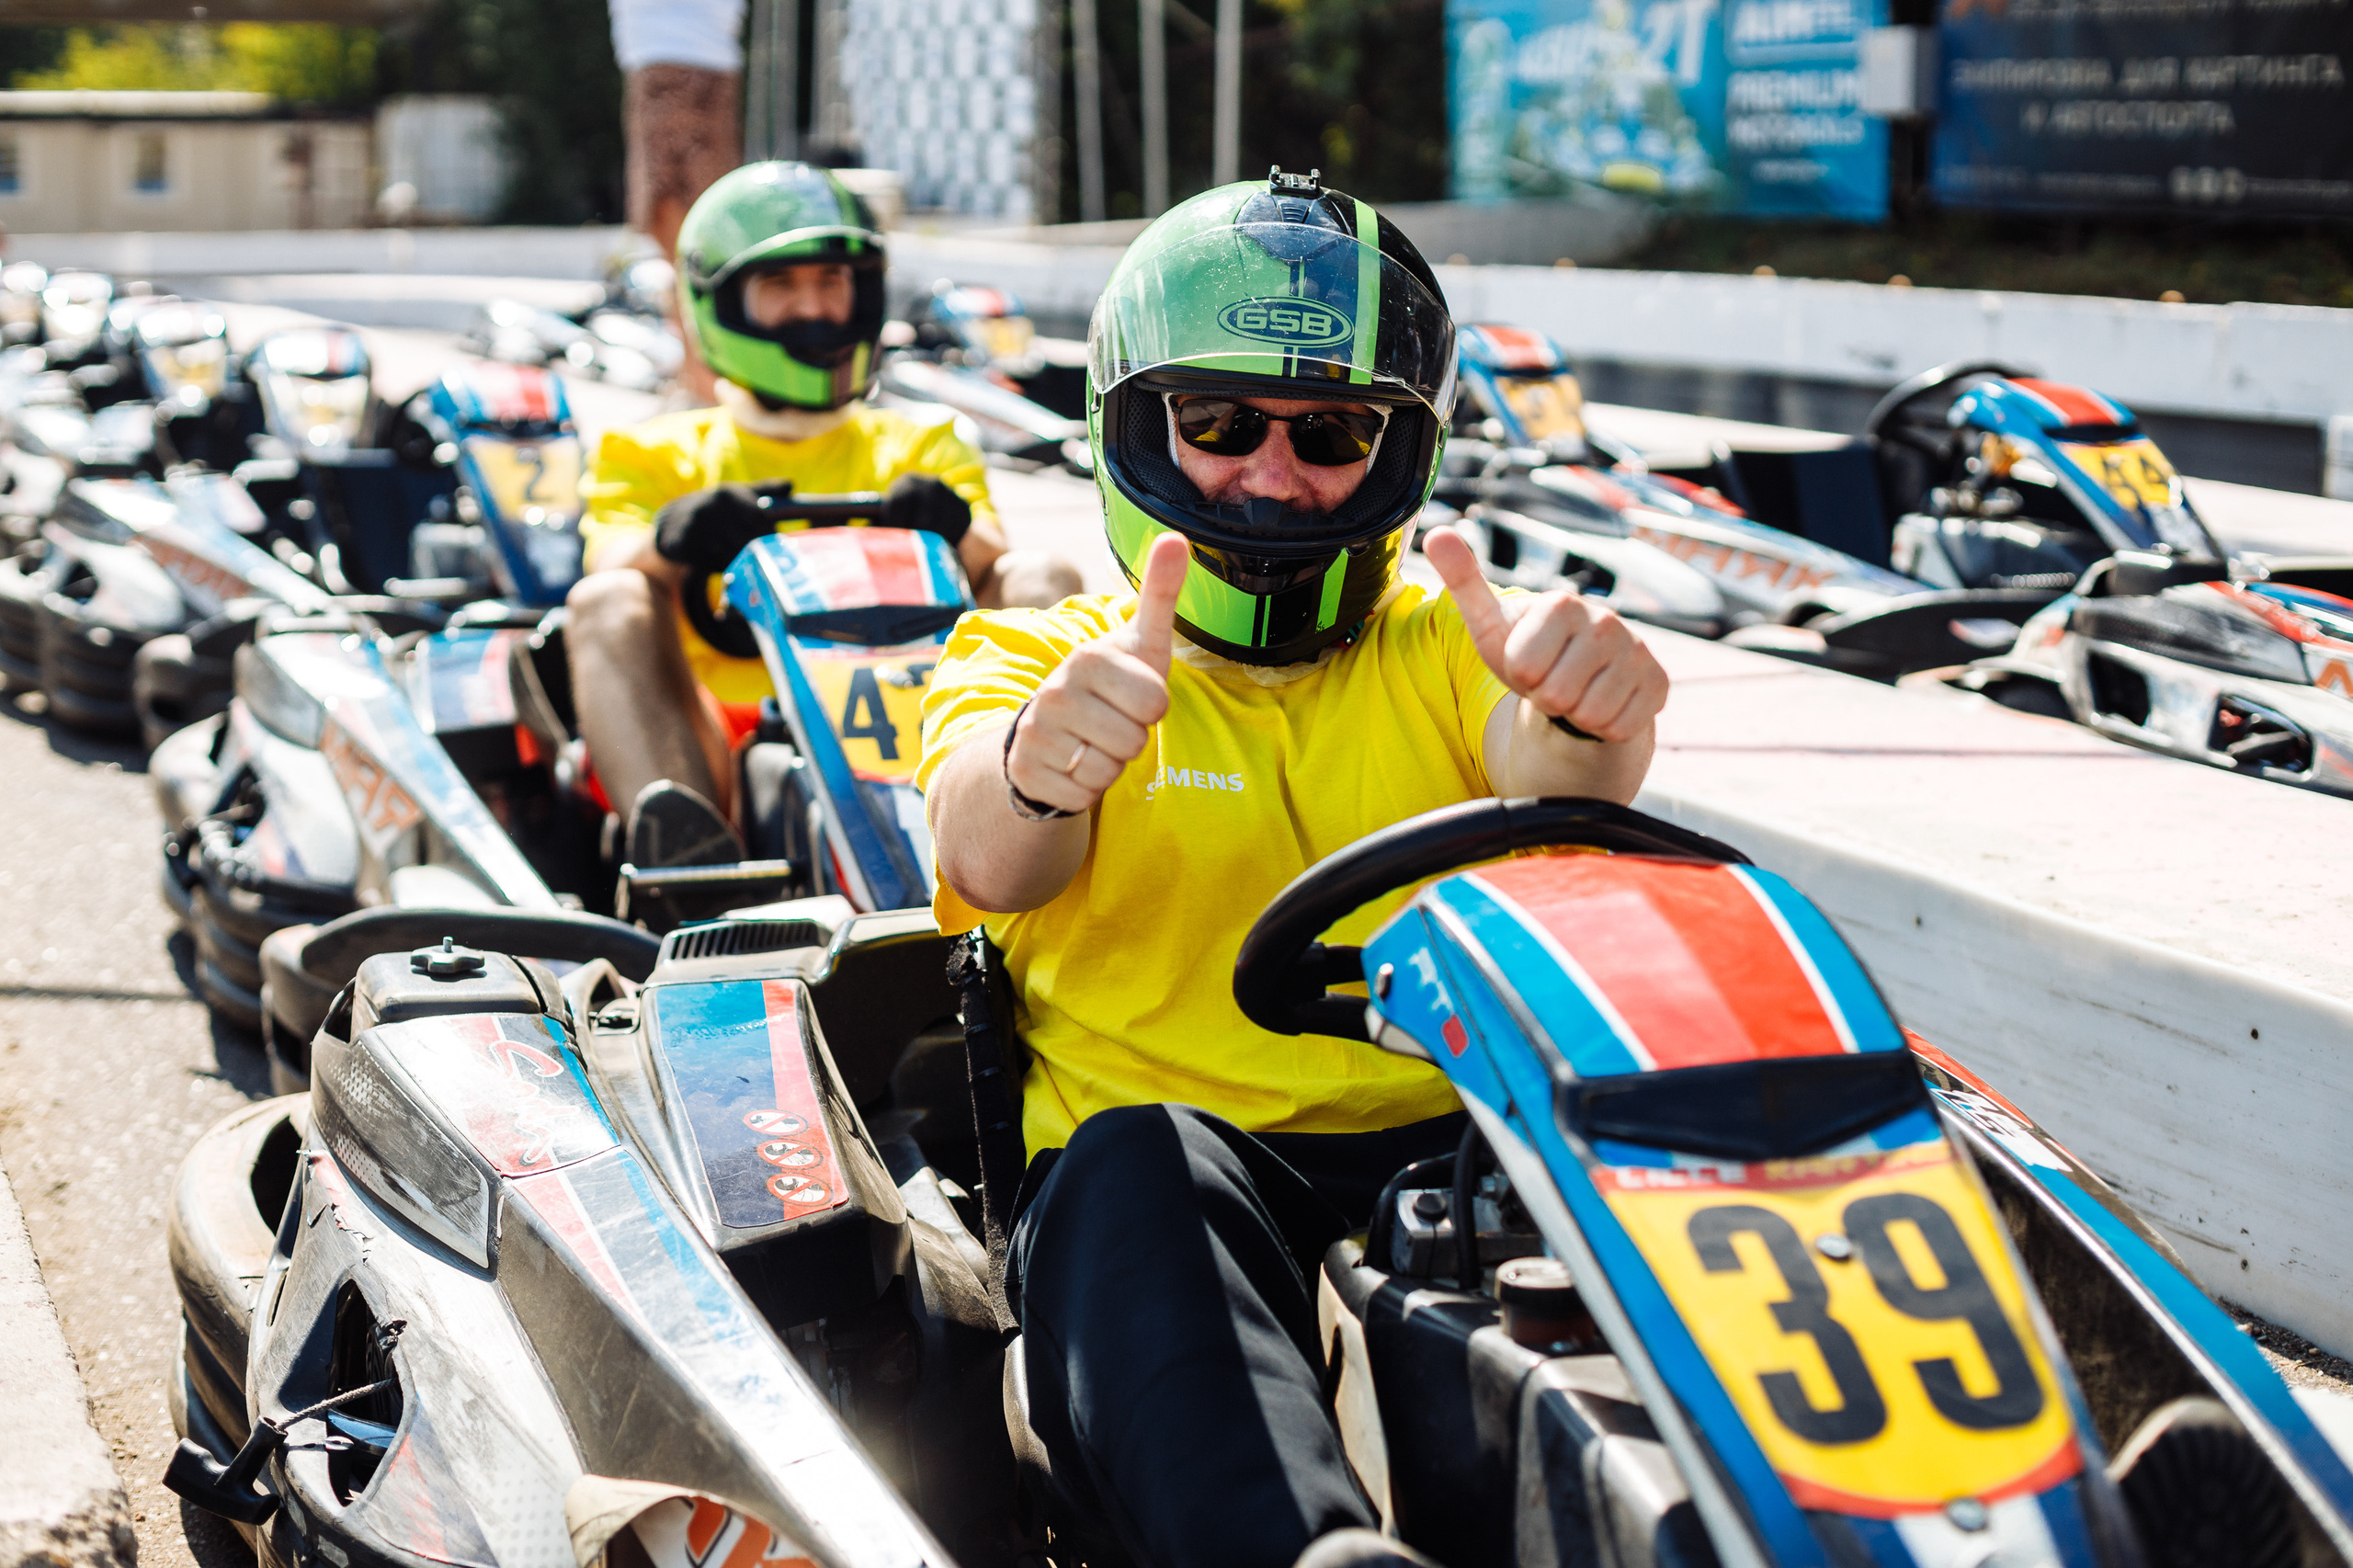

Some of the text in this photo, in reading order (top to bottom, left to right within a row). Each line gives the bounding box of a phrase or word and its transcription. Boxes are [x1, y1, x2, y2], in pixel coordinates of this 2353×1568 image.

[2184, 55, 2344, 89] КАРТИНГА
[1236, 308, 1332, 337] GSB
[1145, 766, 1245, 801] SEMENS
[1686, 1192, 2047, 1447] 39
